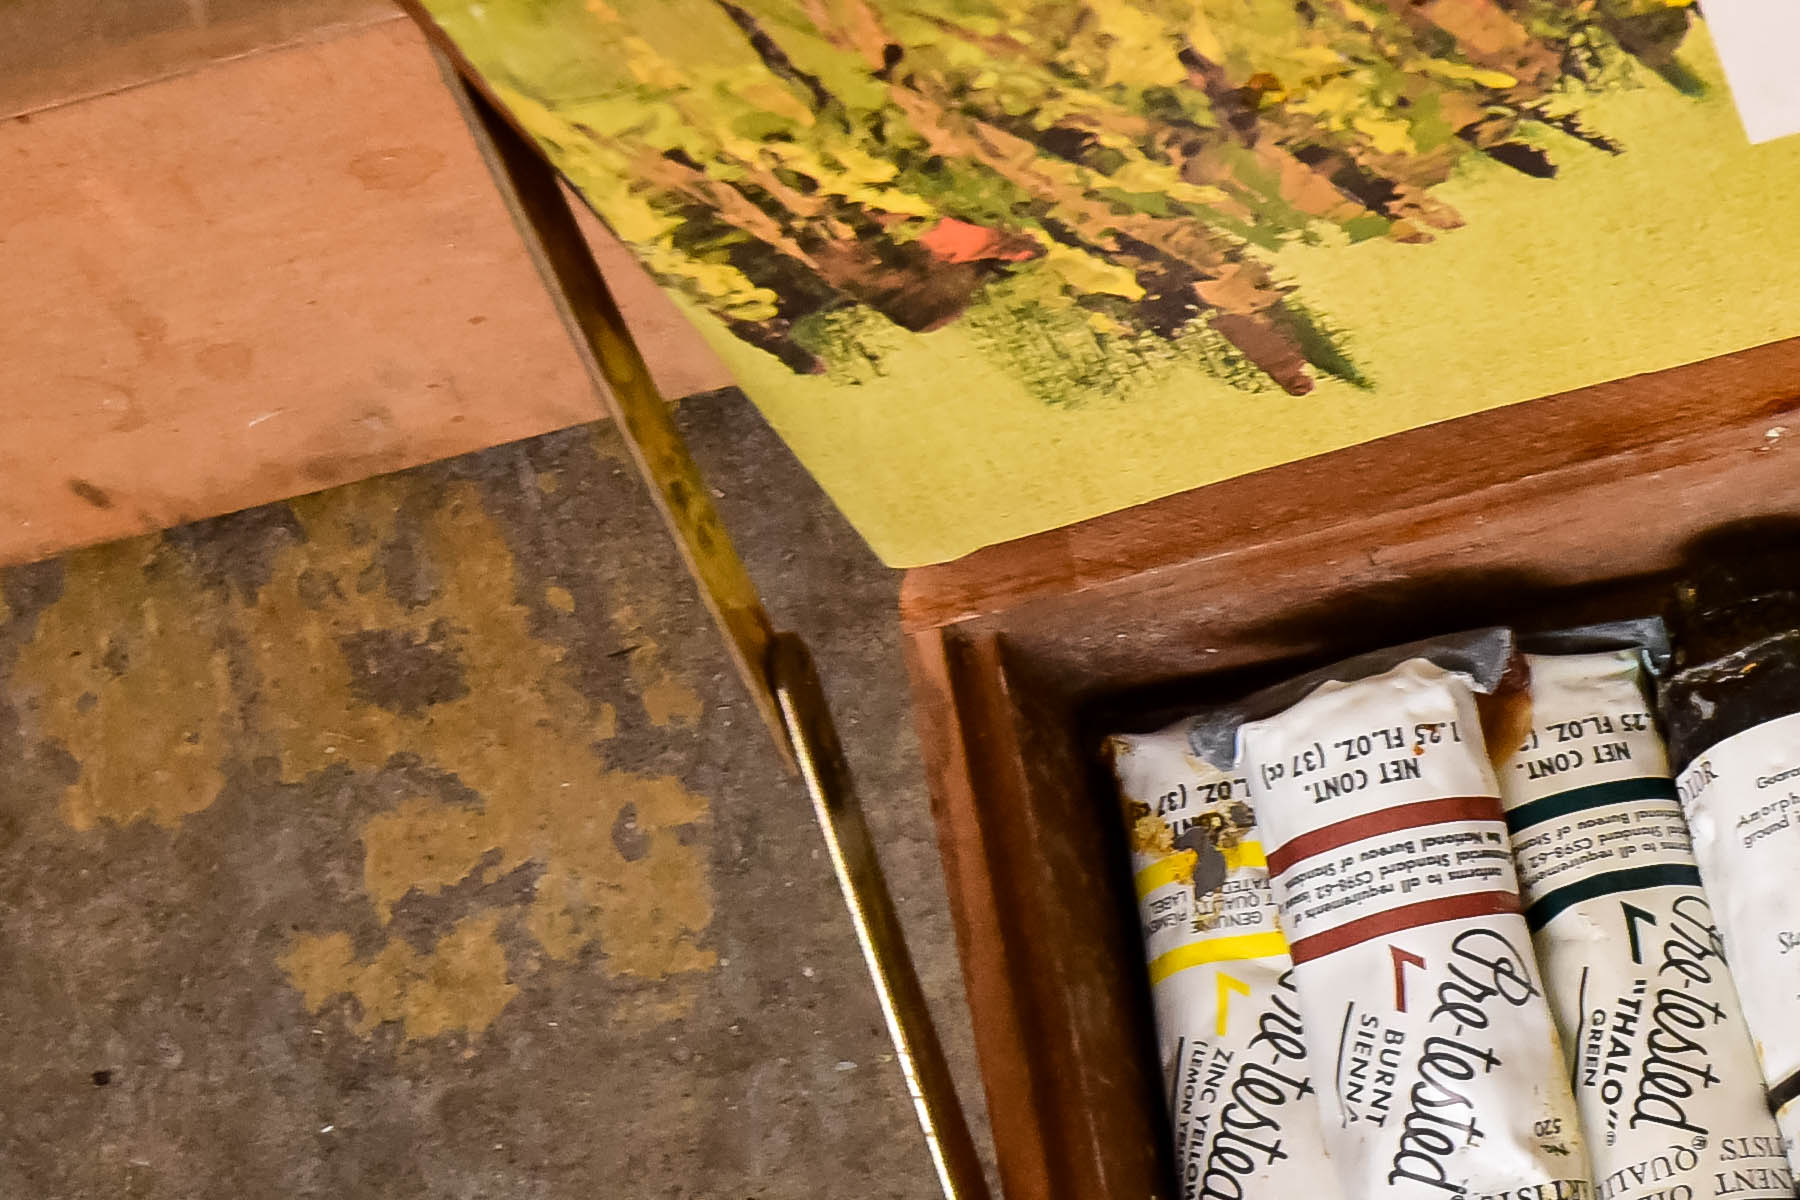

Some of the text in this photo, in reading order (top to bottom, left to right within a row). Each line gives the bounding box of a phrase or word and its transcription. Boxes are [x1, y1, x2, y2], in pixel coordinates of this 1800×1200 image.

[1293, 743, 1324, 777] (37
[1335, 727, 1404, 761] FL.OZ.
[1514, 742, 1631, 779] NET CONT.
[1262, 763, 1284, 789] cc)
[1305, 758, 1420, 803] NET CONT.
[1315, 871, 1373, 899] CS98-62
[1401, 878, 1420, 893] all
[1388, 929, 1553, 1198] Pre-tested
[1583, 1010, 1605, 1086] GREEN
[1200, 1048, 1233, 1103] ZINC
[1366, 1029, 1404, 1127] BURNT
